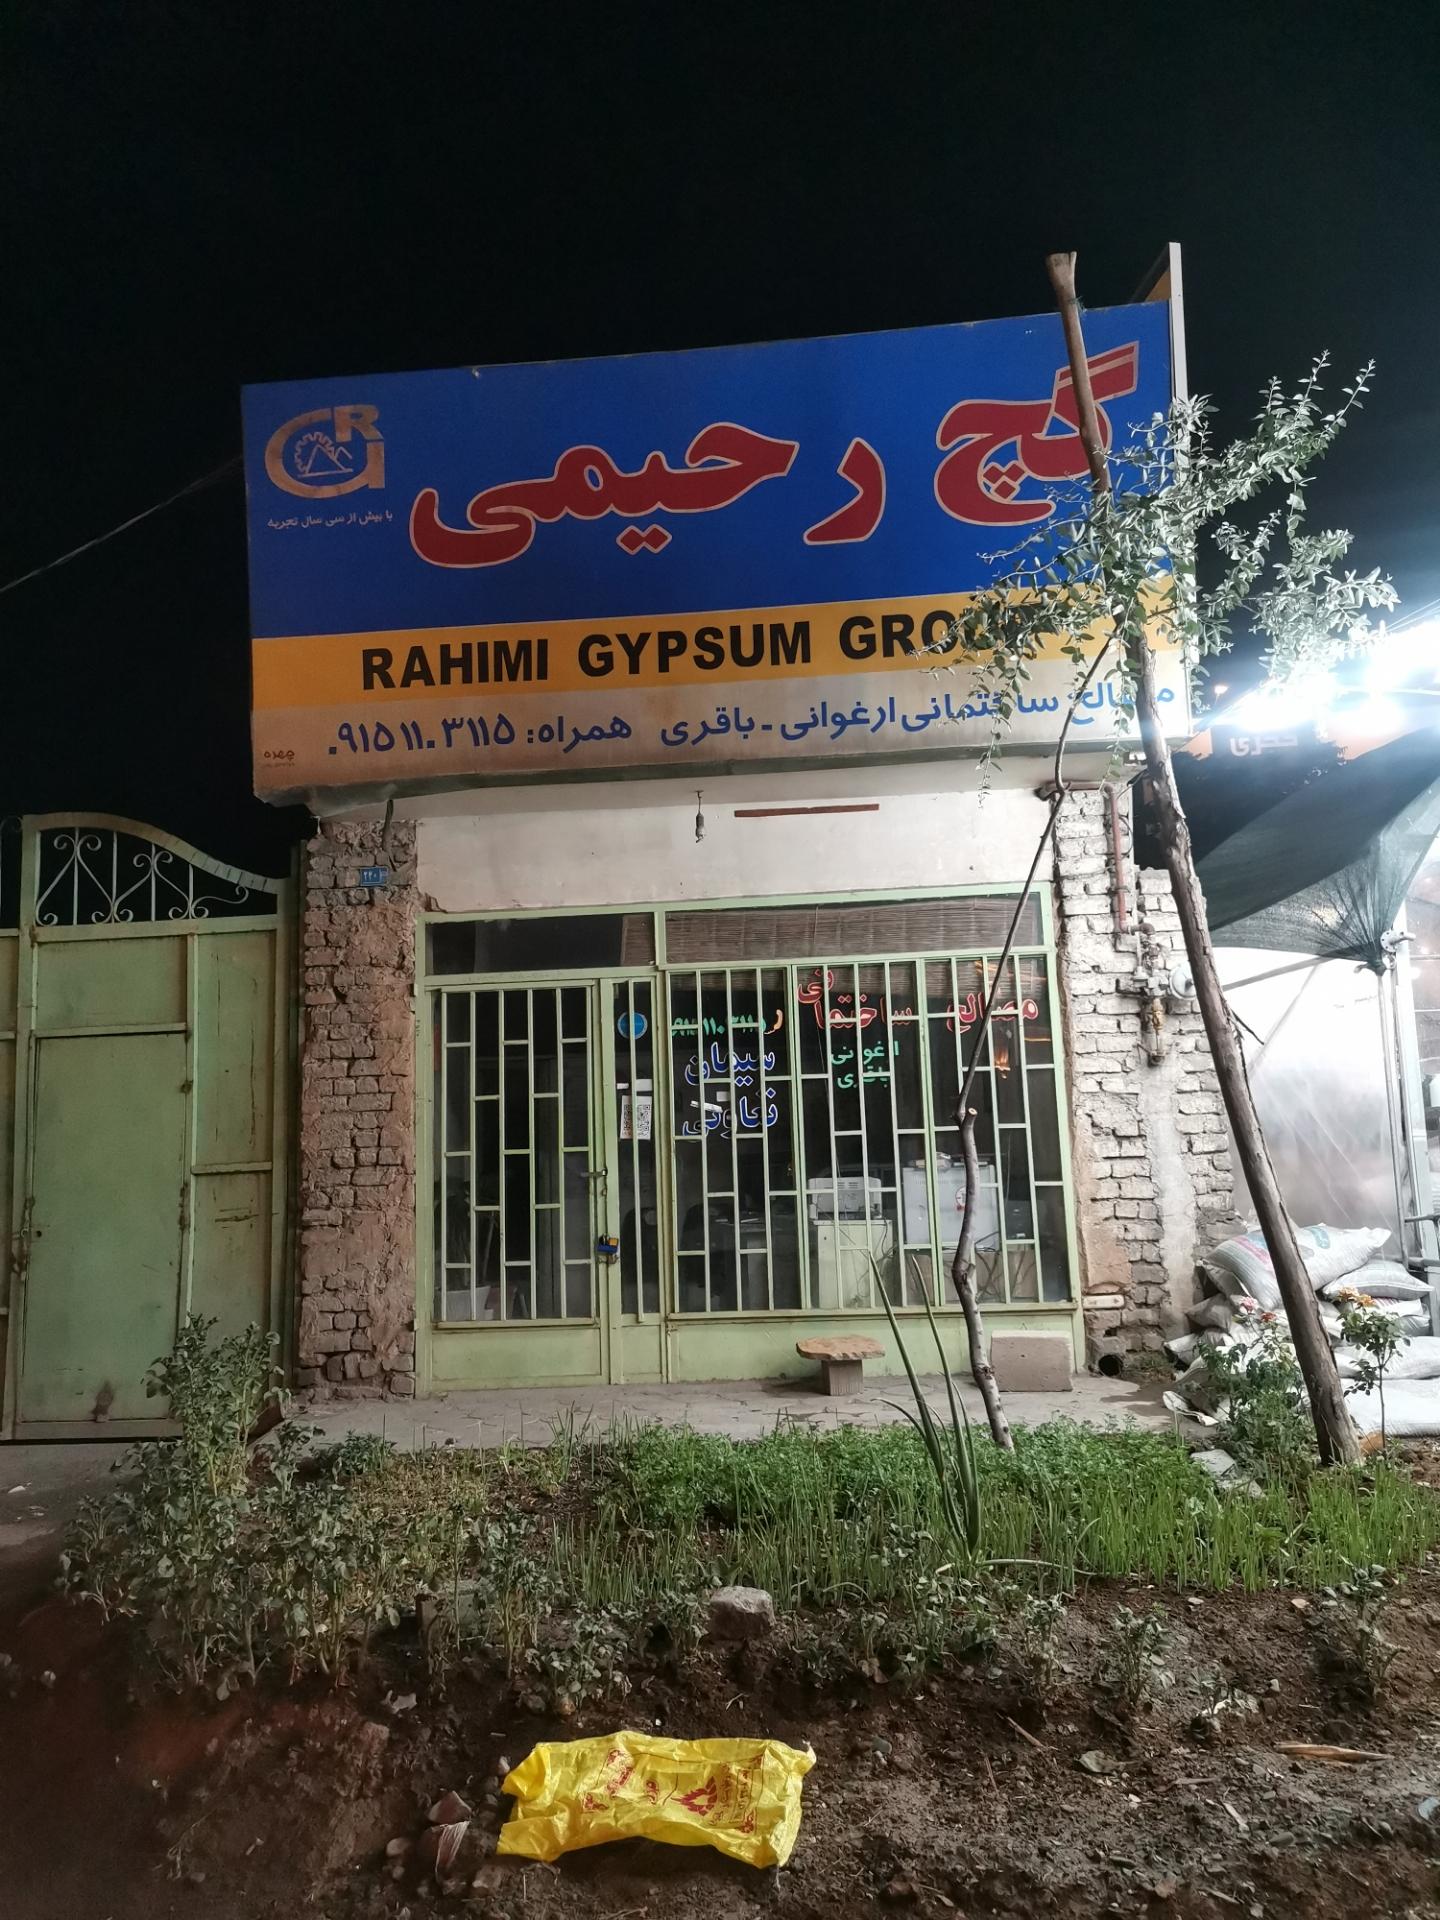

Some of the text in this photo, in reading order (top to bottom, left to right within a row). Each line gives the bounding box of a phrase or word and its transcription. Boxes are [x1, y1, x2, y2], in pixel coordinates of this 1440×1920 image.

[409, 340, 1140, 569] گچ رحیمی
[267, 509, 393, 530] با بیش از سی سال تجربه
[362, 638, 549, 690] RAHIMI
[577, 620, 812, 678] GYPSUM
[660, 706, 755, 746] باقری
